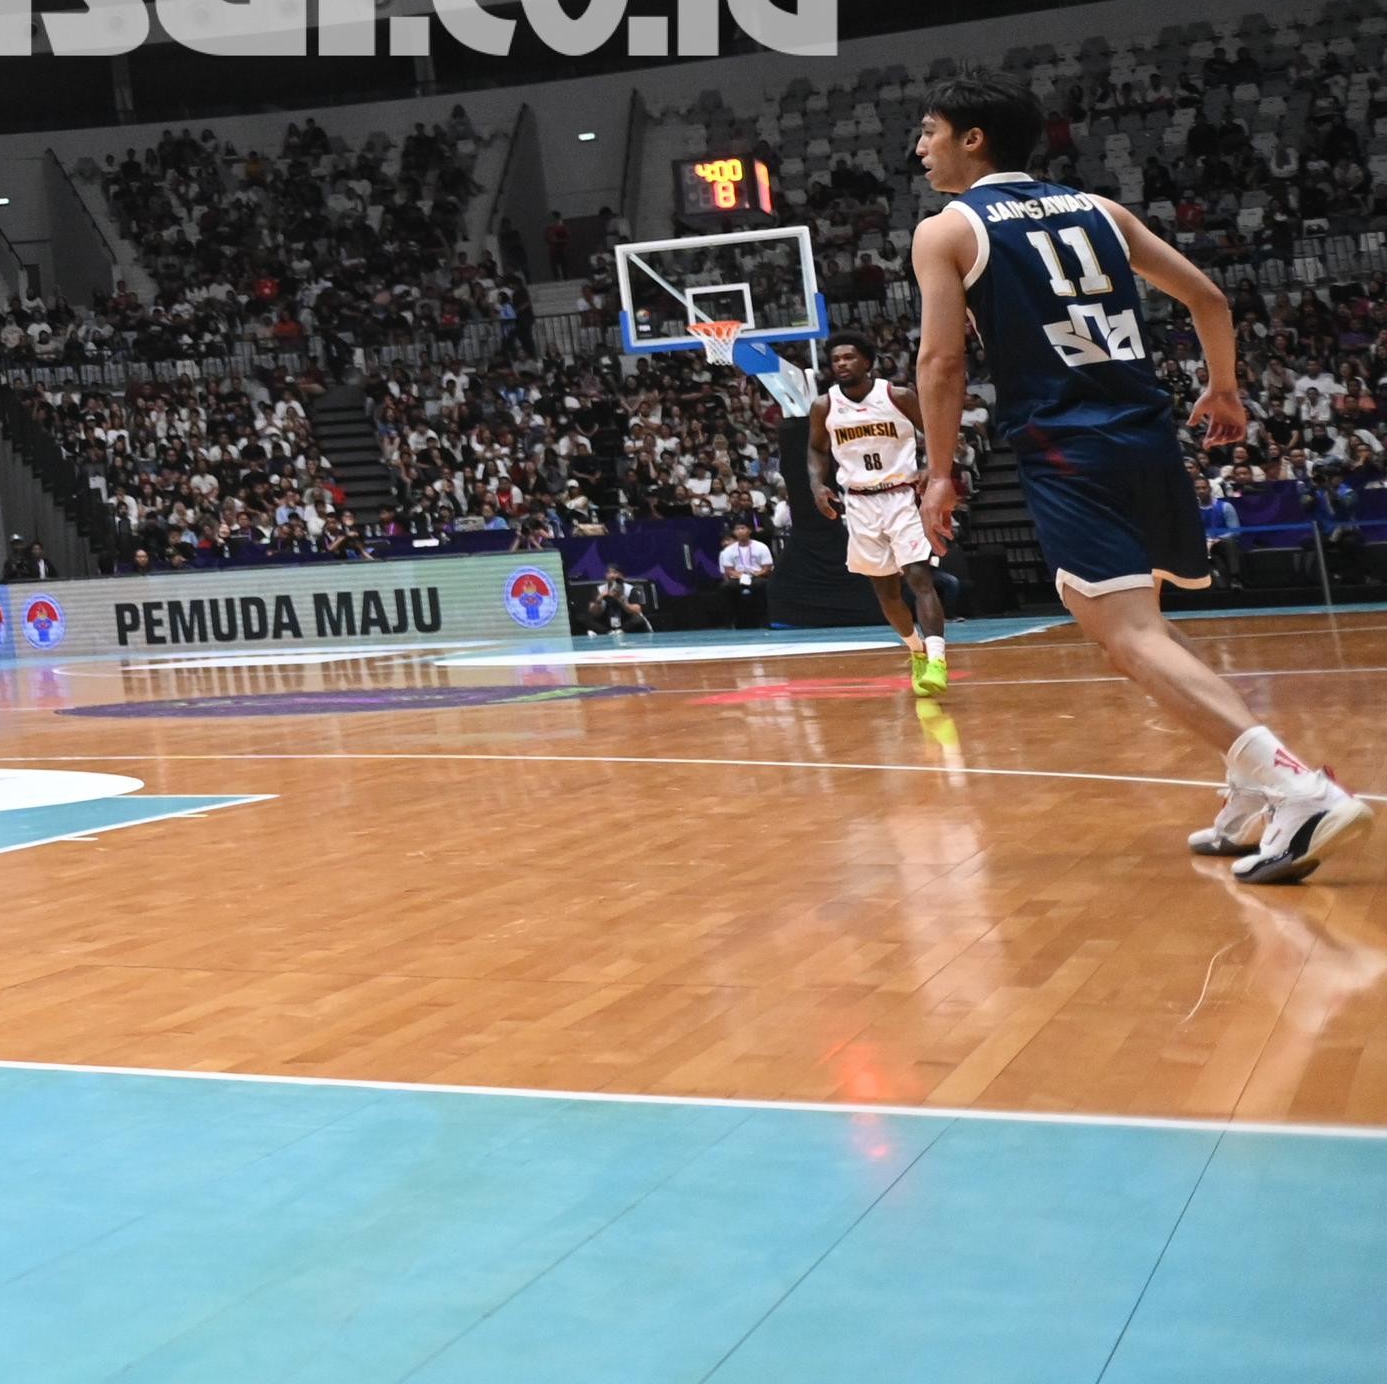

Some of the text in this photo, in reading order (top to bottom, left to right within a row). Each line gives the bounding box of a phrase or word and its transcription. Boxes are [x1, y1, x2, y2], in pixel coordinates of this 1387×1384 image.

[694, 159, 743, 183] 4:00
[714, 181, 736, 208] 8
[1026, 226, 1114, 297] 11
[834, 421, 900, 446] INDONESIA
[863, 452, 883, 471] 88
[115, 594, 304, 647] PEMUDA
[313, 586, 443, 637] MAJU
